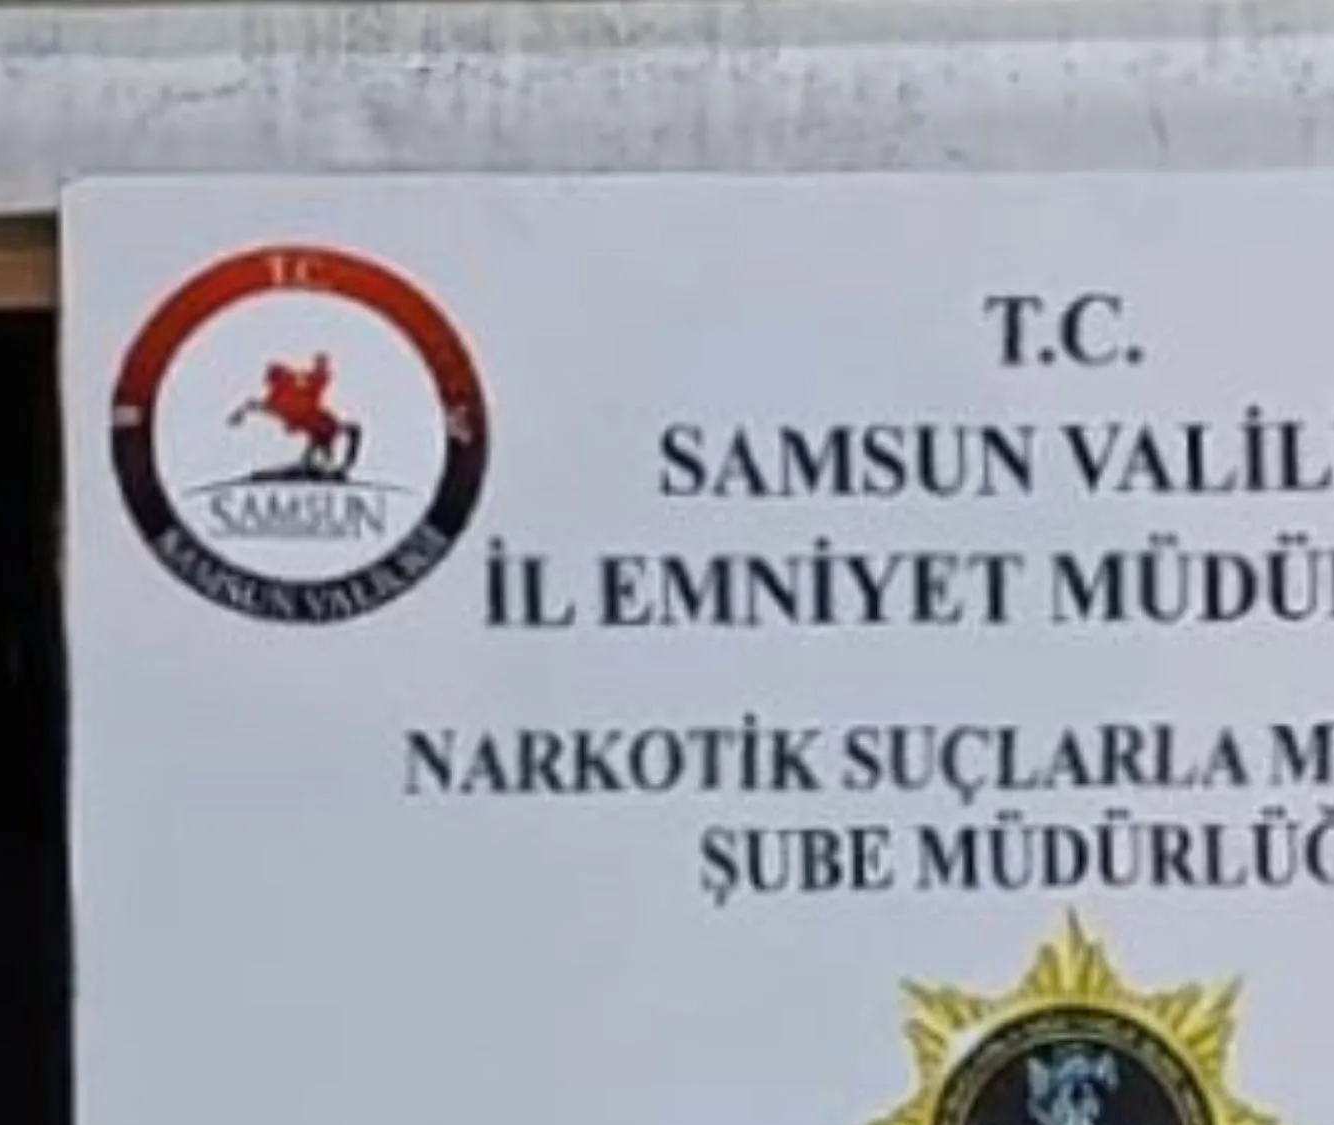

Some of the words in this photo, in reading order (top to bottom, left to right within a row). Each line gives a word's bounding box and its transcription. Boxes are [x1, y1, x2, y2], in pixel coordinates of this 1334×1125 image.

[984, 293, 1145, 366] T.C.
[658, 422, 1036, 498] SAMSUN
[211, 493, 387, 539] SAMSUN
[483, 533, 577, 629] İL
[597, 533, 1025, 628] EMNİYET
[403, 711, 822, 796] NARKOTİK
[840, 720, 1249, 806] SUÇLARLA
[698, 824, 896, 907] ŞUBE
